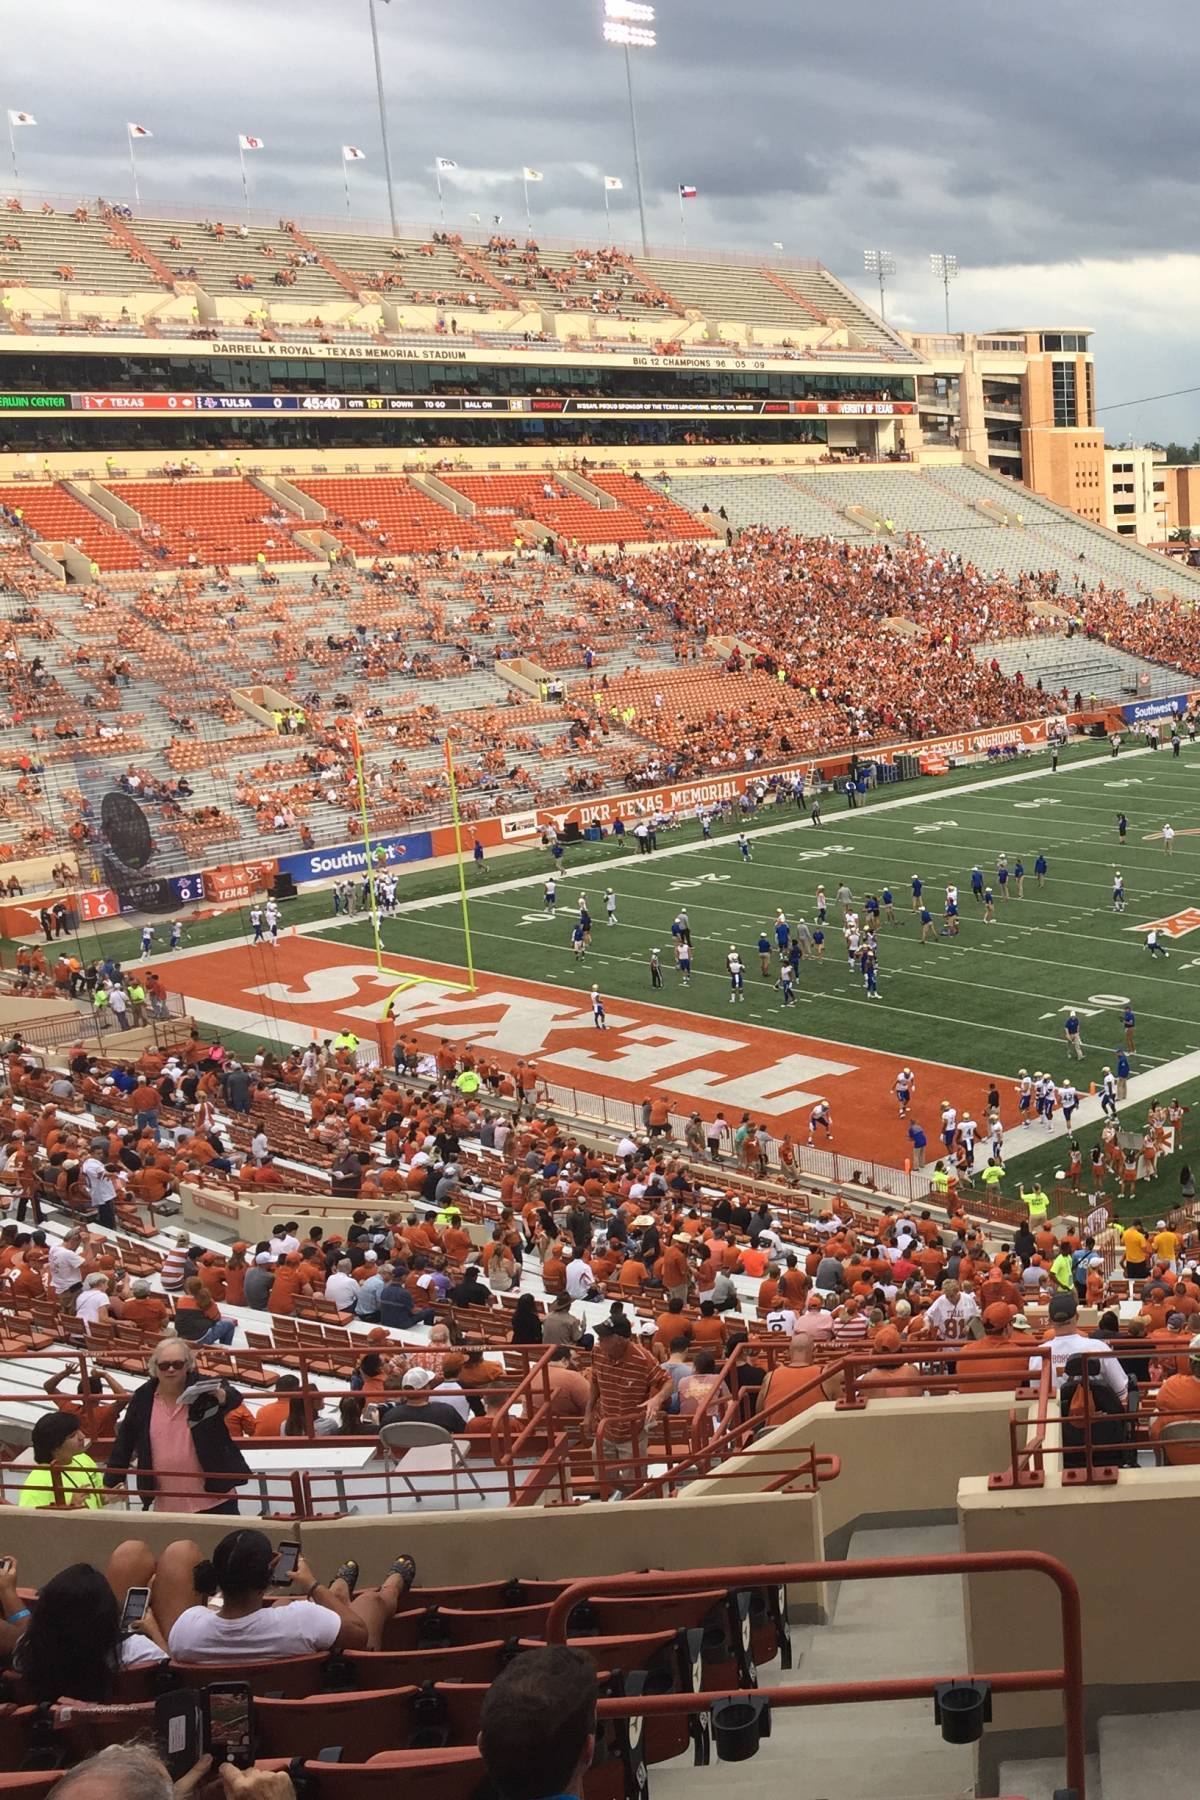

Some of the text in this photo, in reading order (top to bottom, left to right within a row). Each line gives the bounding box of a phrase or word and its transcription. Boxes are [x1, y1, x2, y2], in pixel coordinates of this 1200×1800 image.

[212, 344, 265, 355] DARRELL
[269, 345, 276, 355] K
[280, 346, 316, 356] ROYAL
[326, 347, 363, 357] TEXAS
[365, 349, 420, 359] MEMORIAL
[422, 350, 467, 360] STADIUM
[633, 357, 647, 365] BIG
[650, 358, 659, 366] 12
[663, 358, 711, 367] CHAMPIONS
[31, 396, 65, 407] CENTER
[109, 398, 144, 408] TEXAS
[168, 397, 177, 408] 0
[220, 398, 252, 408] TULSA
[273, 397, 282, 408] 0
[302, 397, 340, 410] 45:40
[349, 400, 363, 408] QTR
[367, 399, 384, 409] 1ST
[391, 400, 413, 409] DOWN
[434, 401, 446, 409] GO
[464, 401, 481, 409] BALL
[1134, 701, 1172, 718] Southwest
[967, 728, 1022, 750] LONGHORNS
[580, 795, 664, 825] DKR-TEXAS
[671, 785, 741, 812] MEMORIAL
[218, 886, 249, 900] TEXAS
[1056, 993, 1131, 1018] 10
[242, 964, 860, 1117] TEXAS
[944, 1318, 967, 1339] 81
